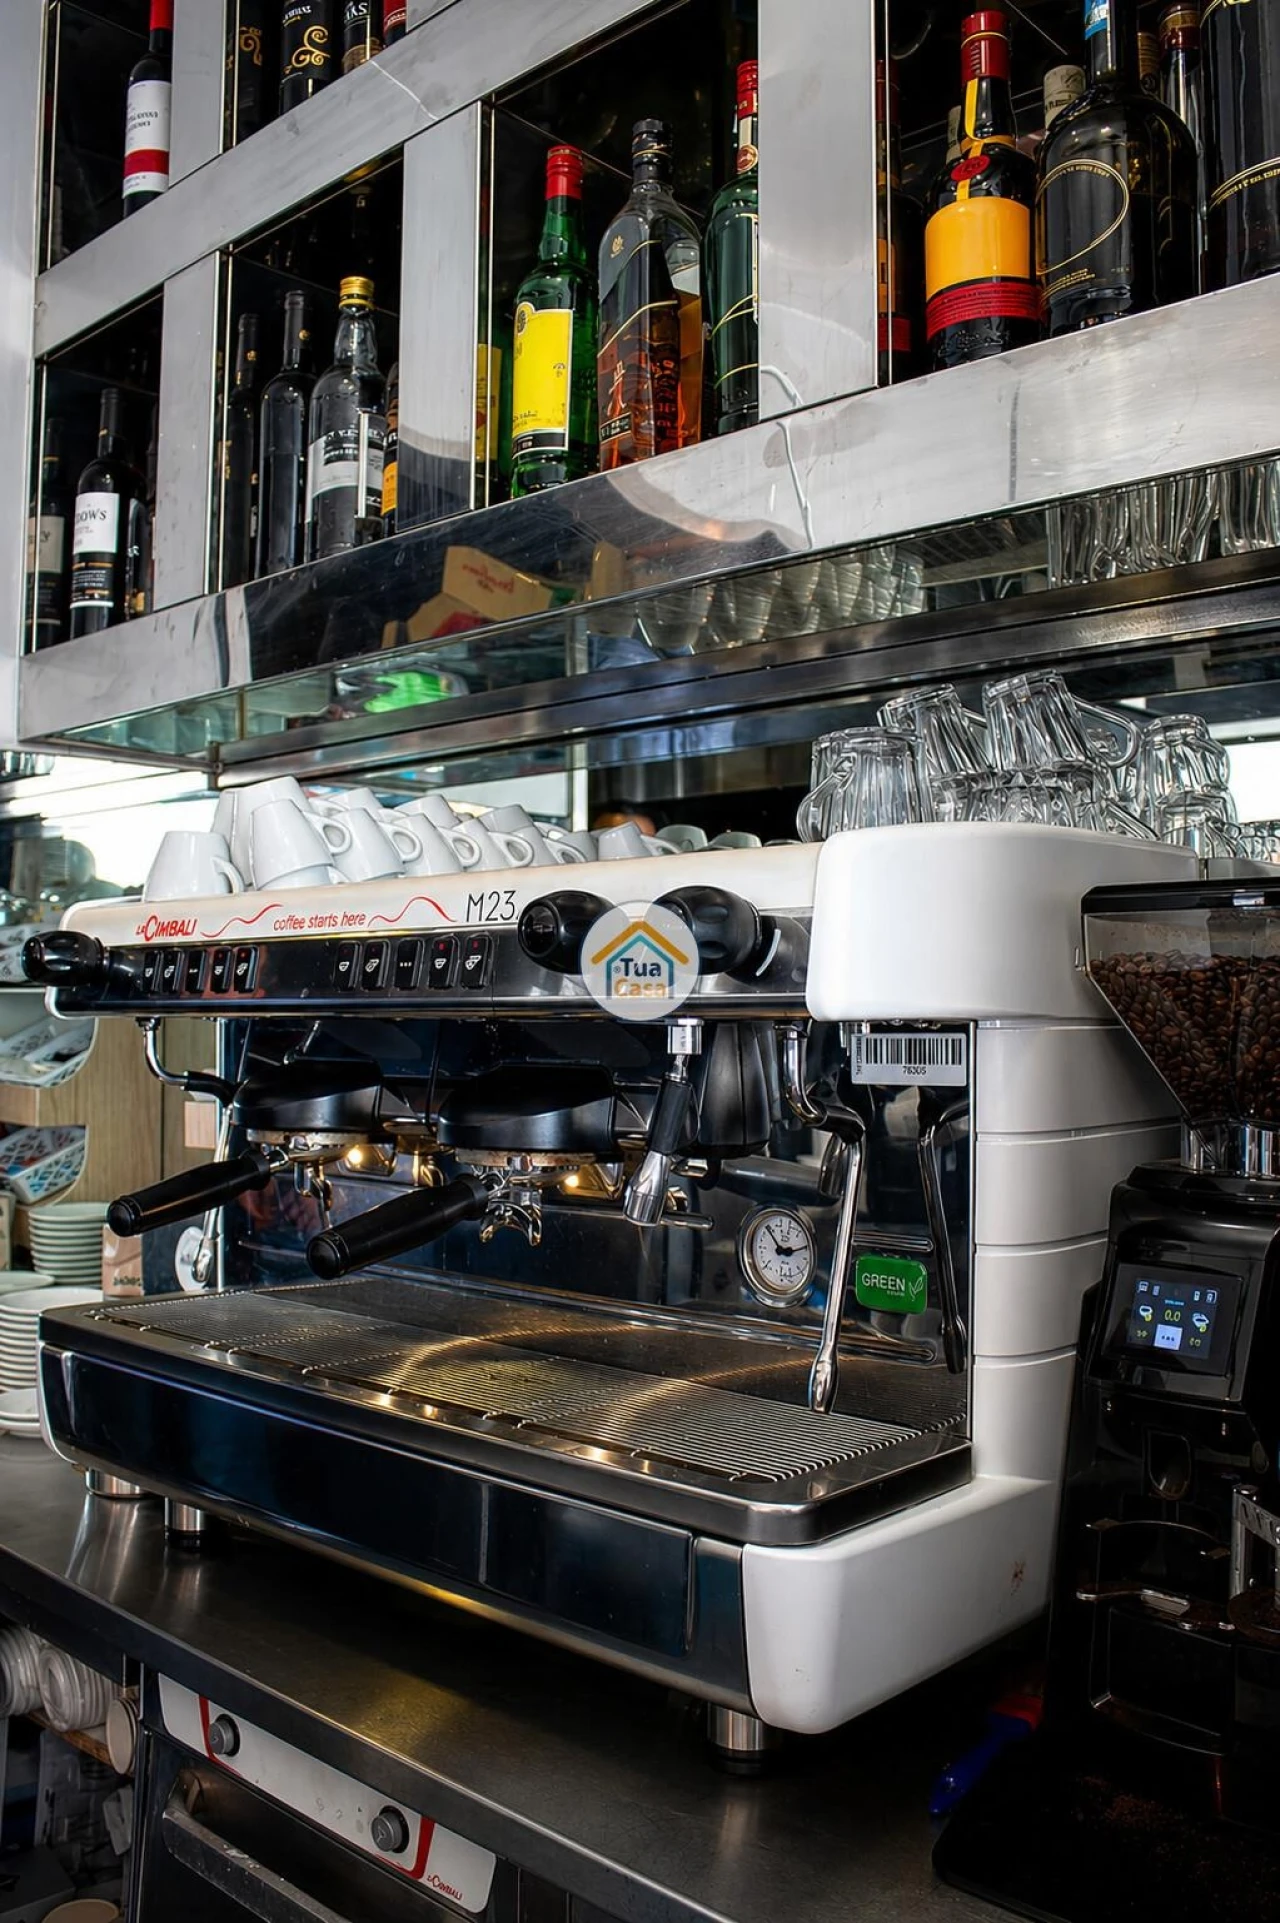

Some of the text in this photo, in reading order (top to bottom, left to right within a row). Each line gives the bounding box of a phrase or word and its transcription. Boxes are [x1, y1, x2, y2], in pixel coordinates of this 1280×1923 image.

[466, 890, 516, 922] M23
[144, 914, 198, 942] CIMBALI
[273, 914, 306, 931] coffee
[308, 913, 339, 929] starts
[340, 911, 366, 927] here
[861, 1272, 906, 1292] GREEN
